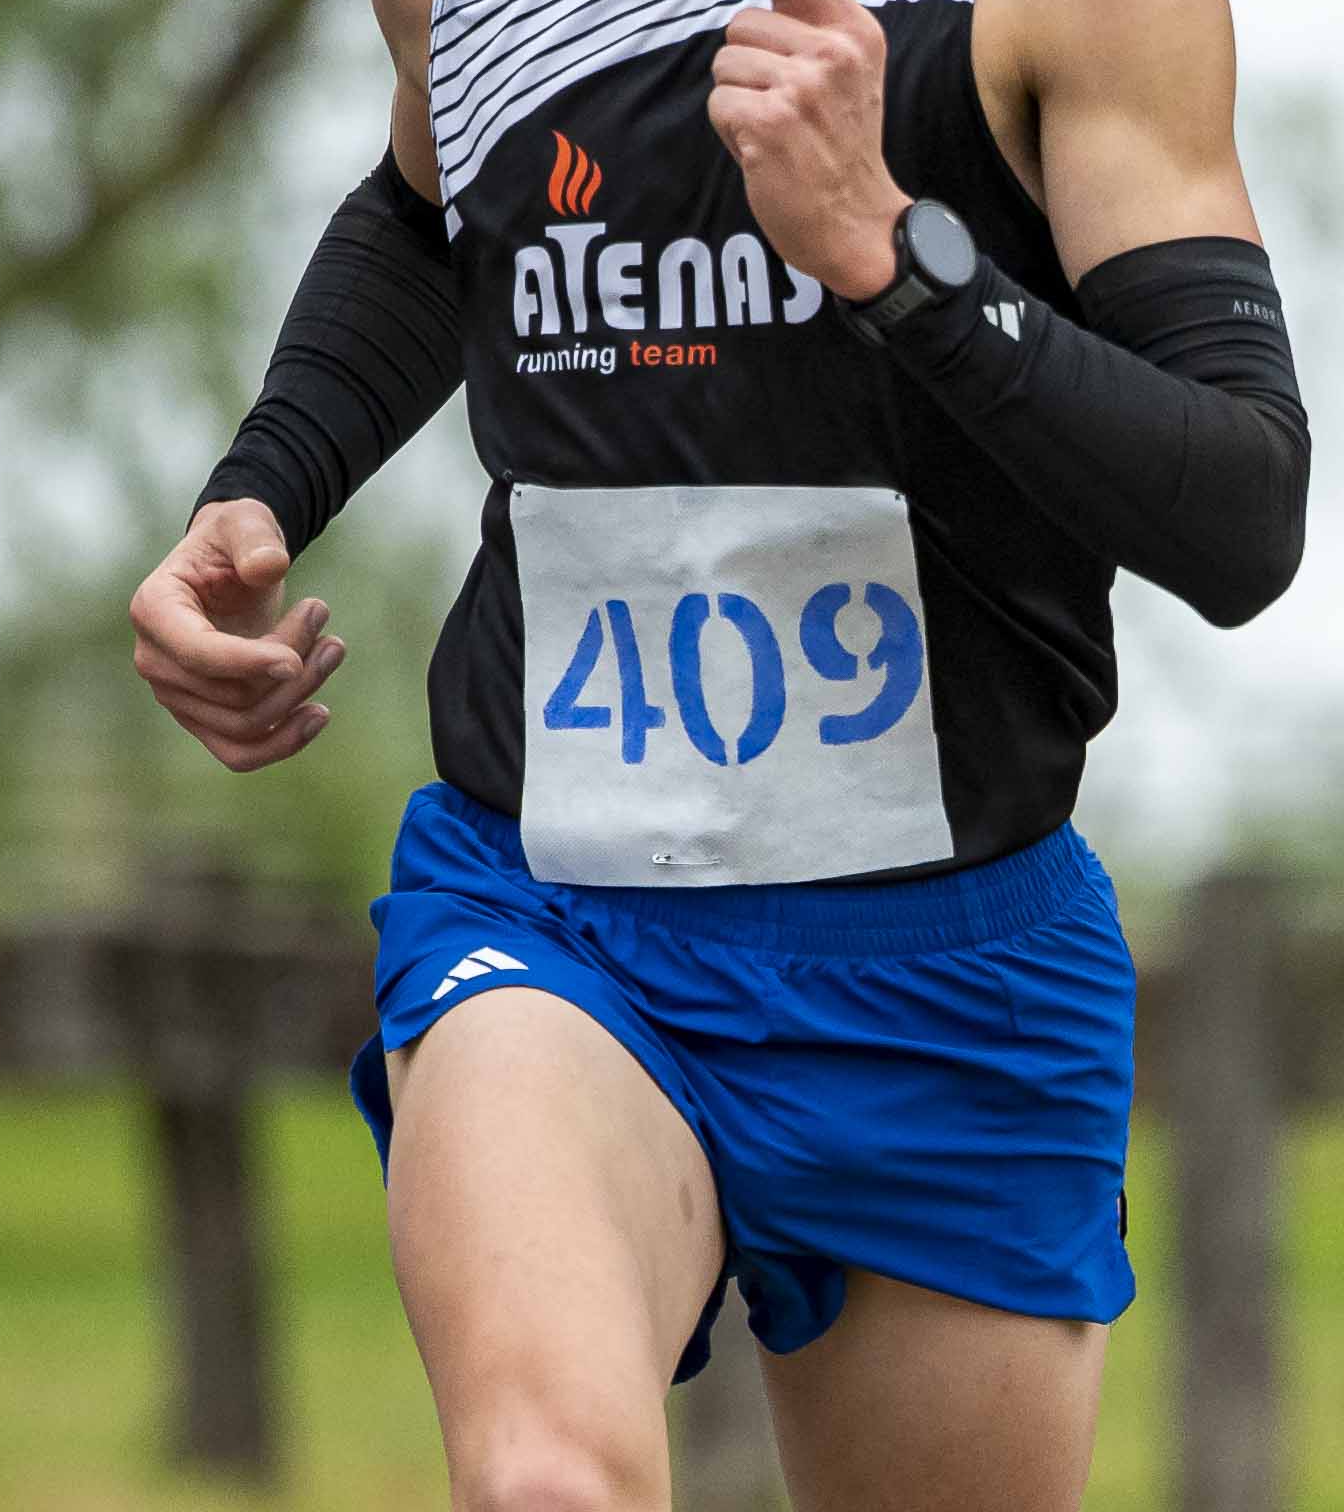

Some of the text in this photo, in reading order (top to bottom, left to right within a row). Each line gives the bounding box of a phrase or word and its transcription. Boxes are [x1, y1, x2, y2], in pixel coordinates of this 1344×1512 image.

[513, 222, 823, 337] ATENAS
[516, 340, 717, 375] running team
[544, 582, 923, 767] 409
